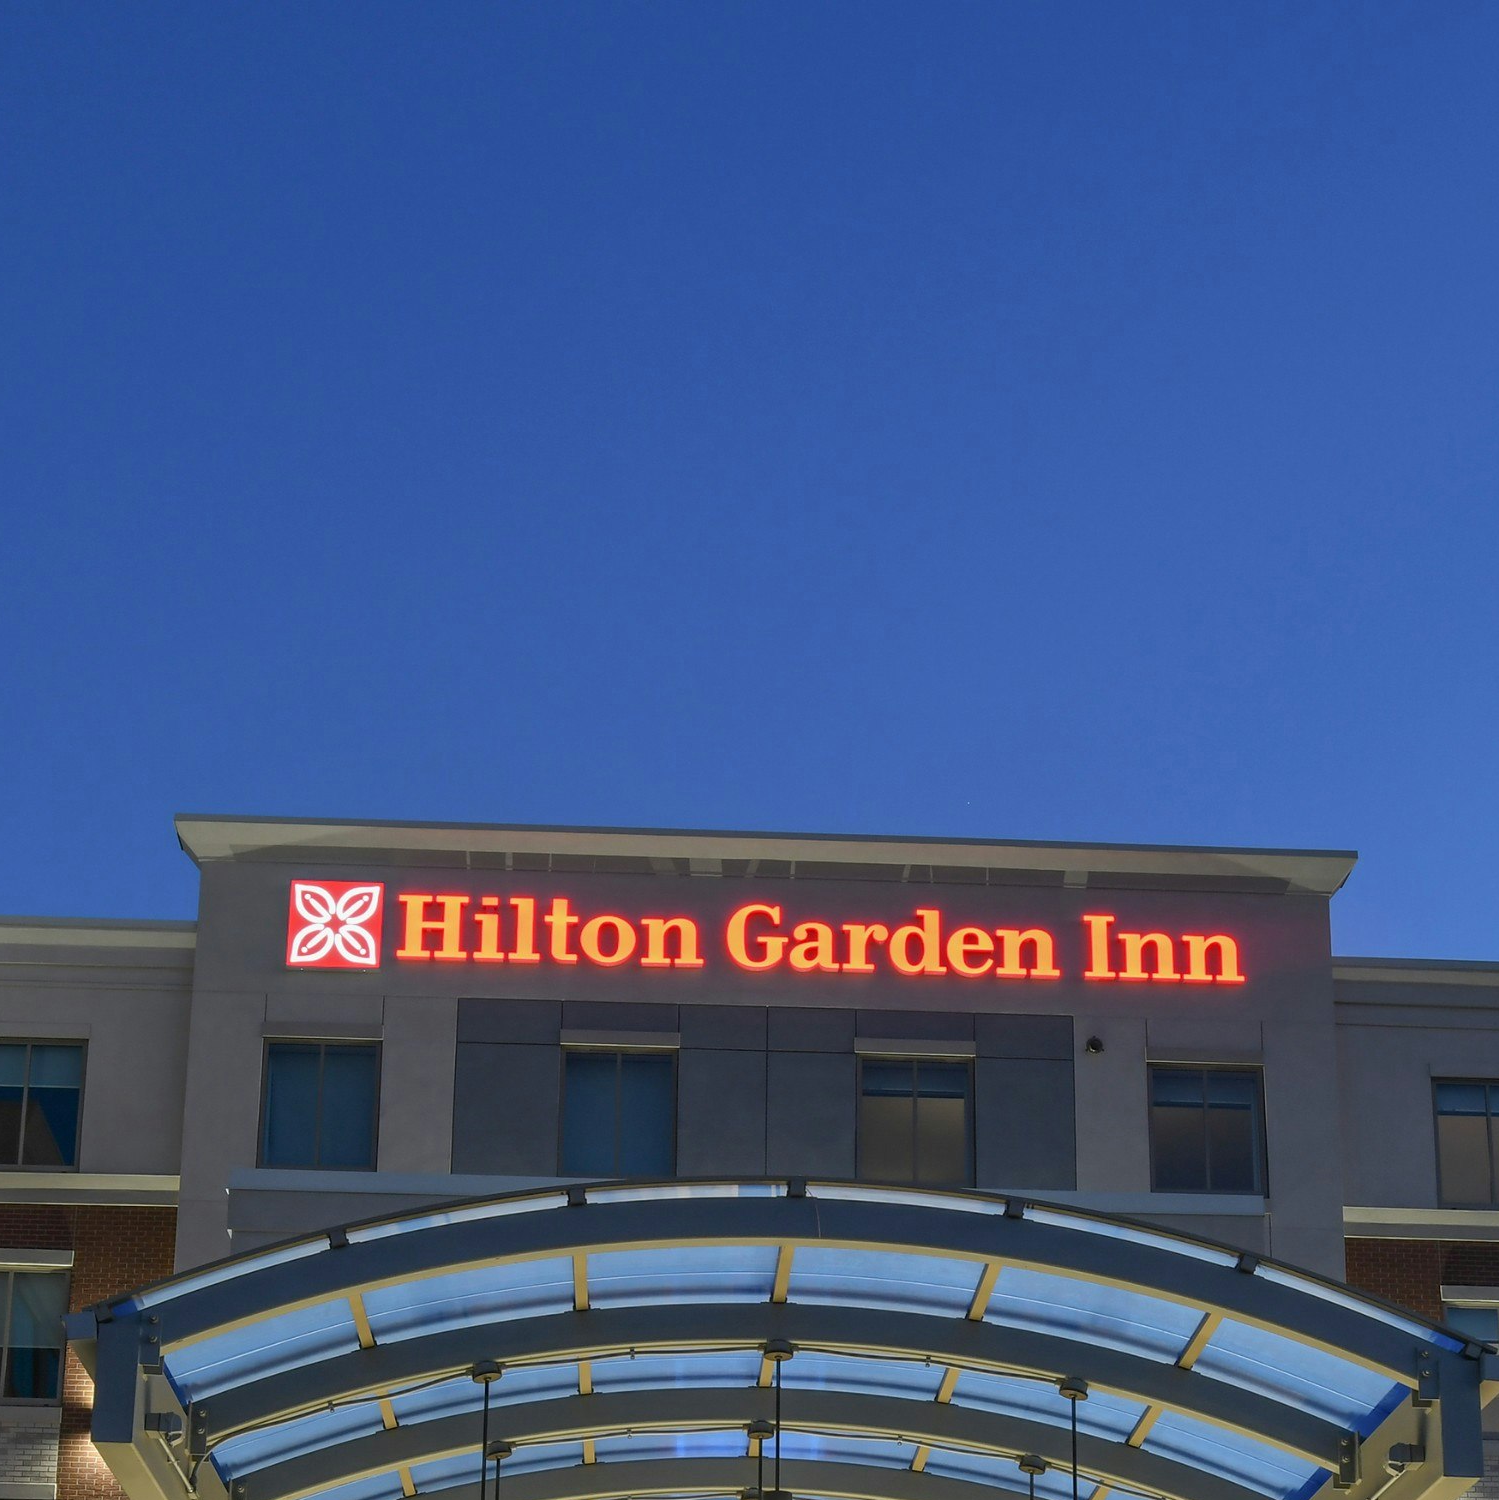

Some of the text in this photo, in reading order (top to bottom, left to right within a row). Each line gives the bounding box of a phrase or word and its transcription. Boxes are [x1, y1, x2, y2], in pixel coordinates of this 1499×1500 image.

[396, 894, 1245, 984] Hilton Garden Inn
